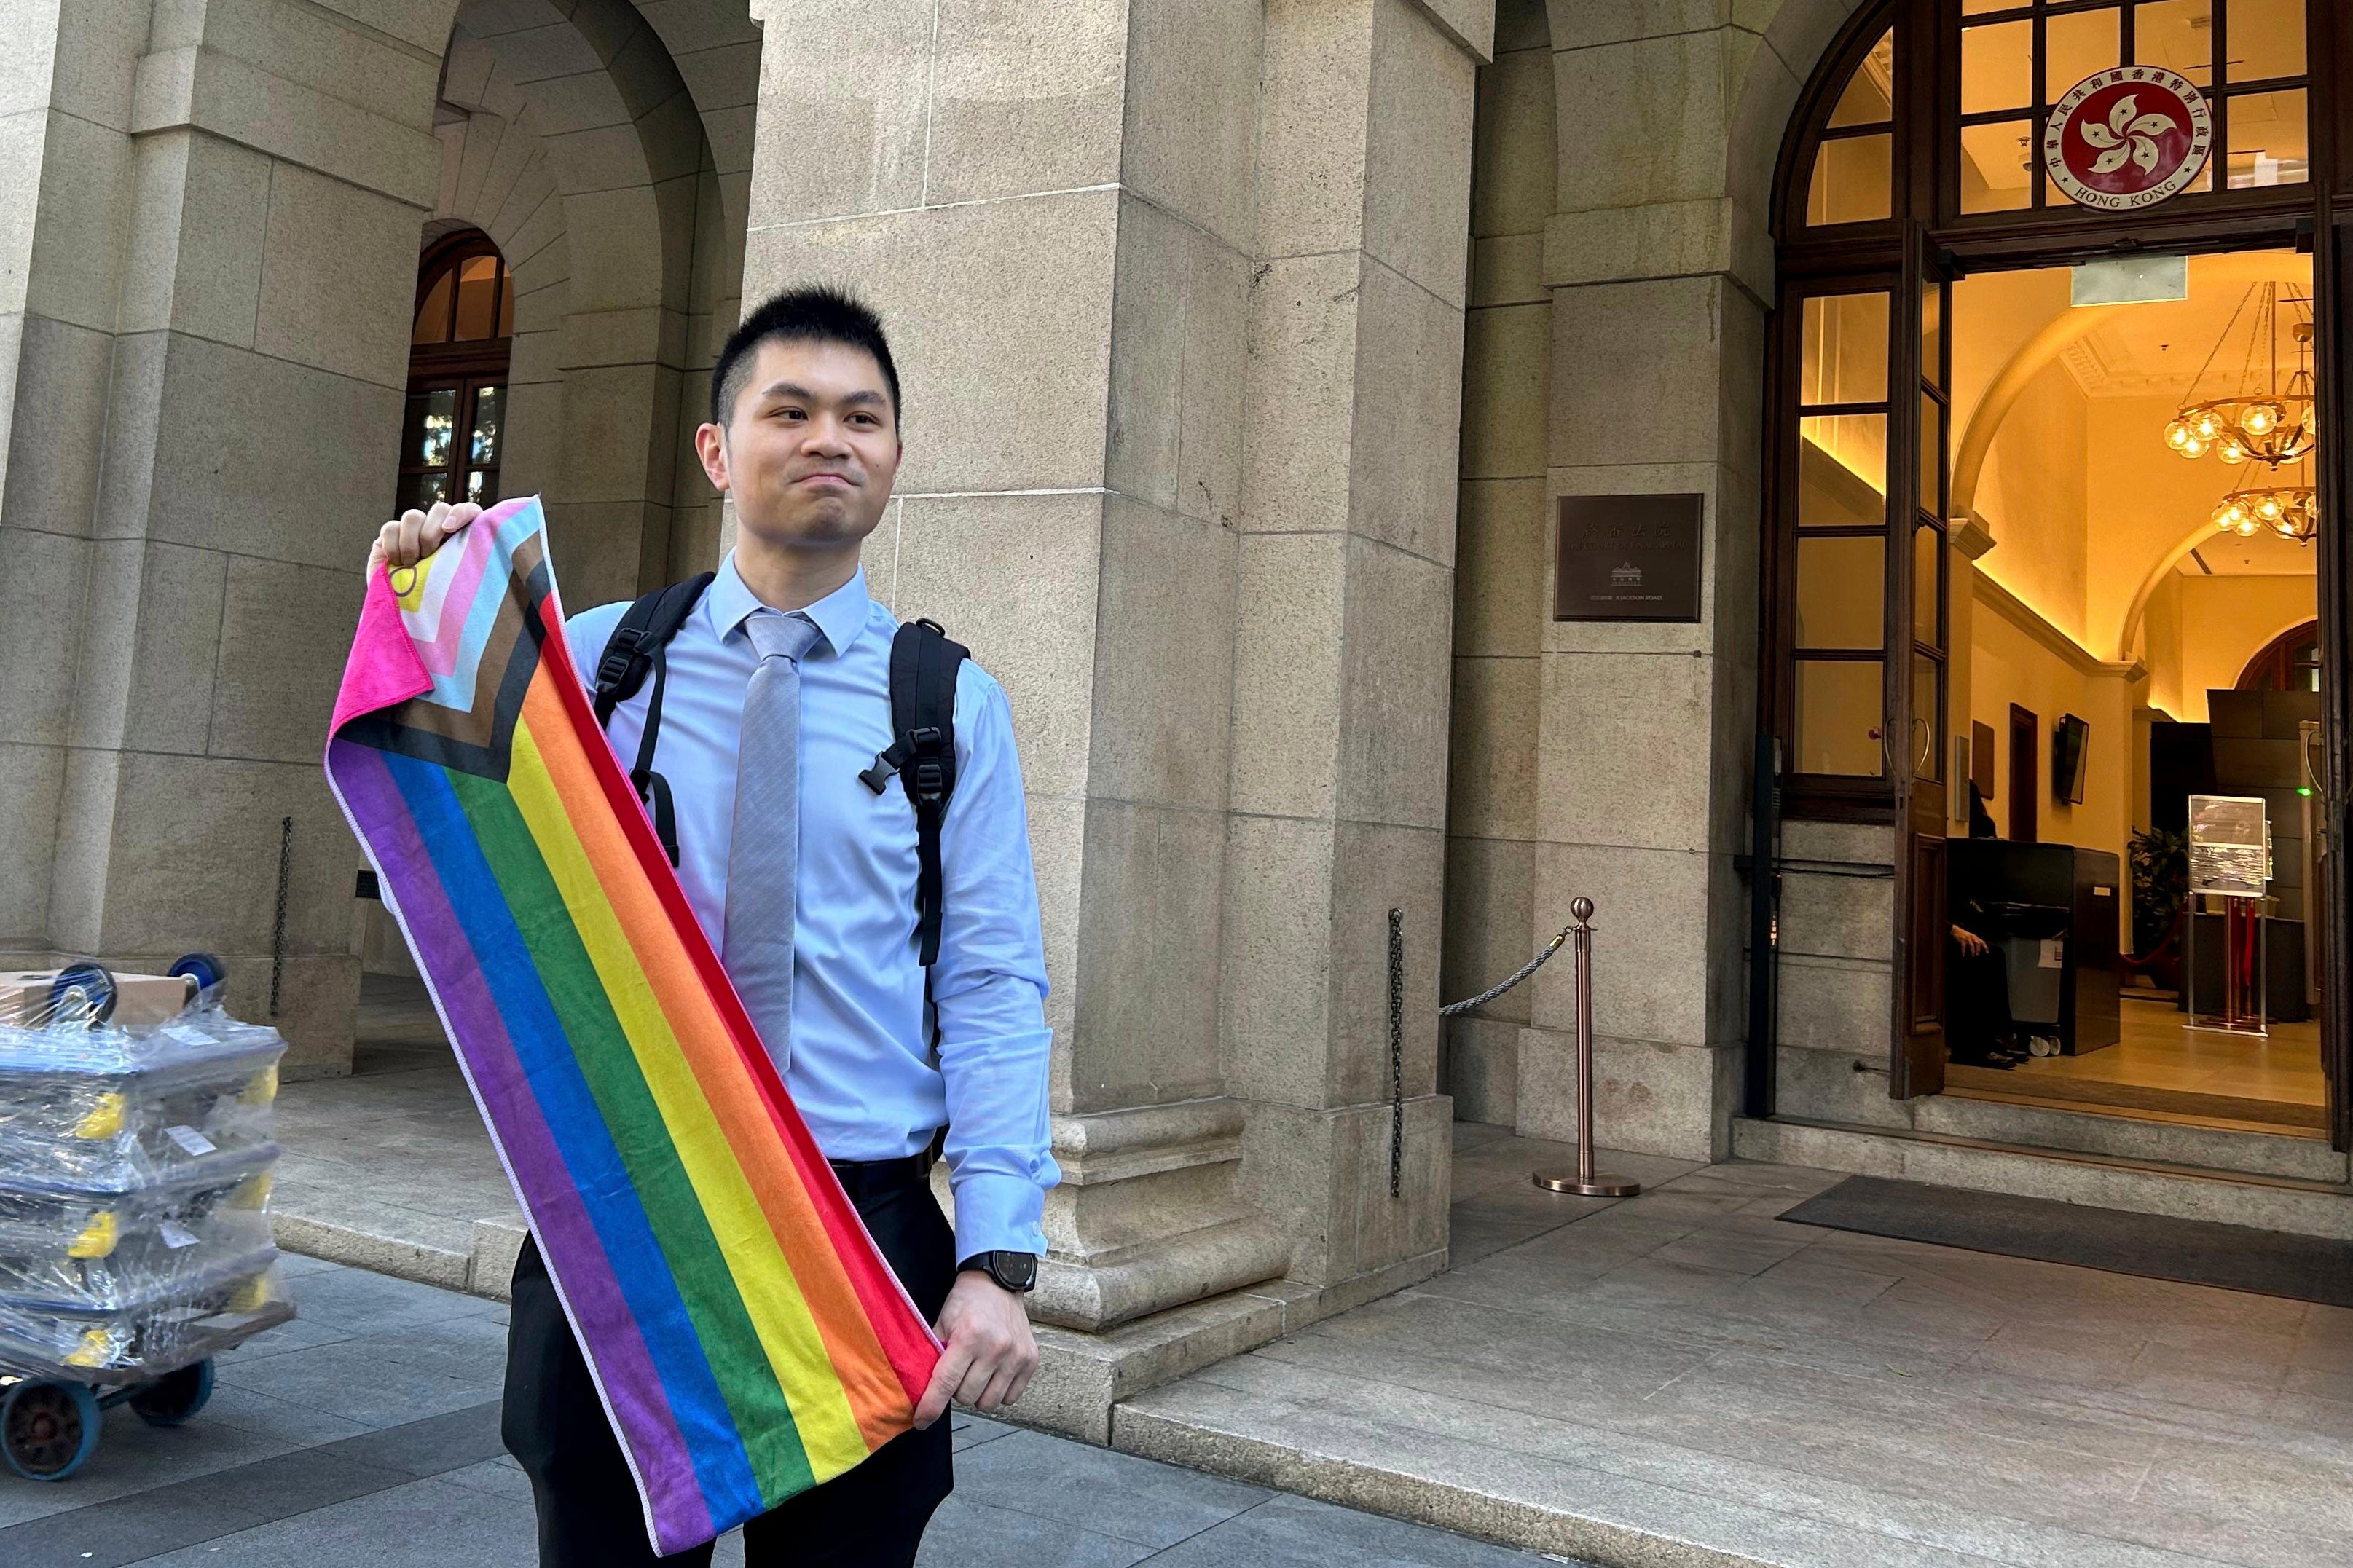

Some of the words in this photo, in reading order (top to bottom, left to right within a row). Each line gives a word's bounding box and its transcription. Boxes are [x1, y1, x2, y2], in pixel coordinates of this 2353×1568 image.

[2046, 69, 2210, 168] 中華人民共和國香港特別行政區
[2074, 186, 2121, 208] HONG
[2129, 181, 2177, 207] KONG
